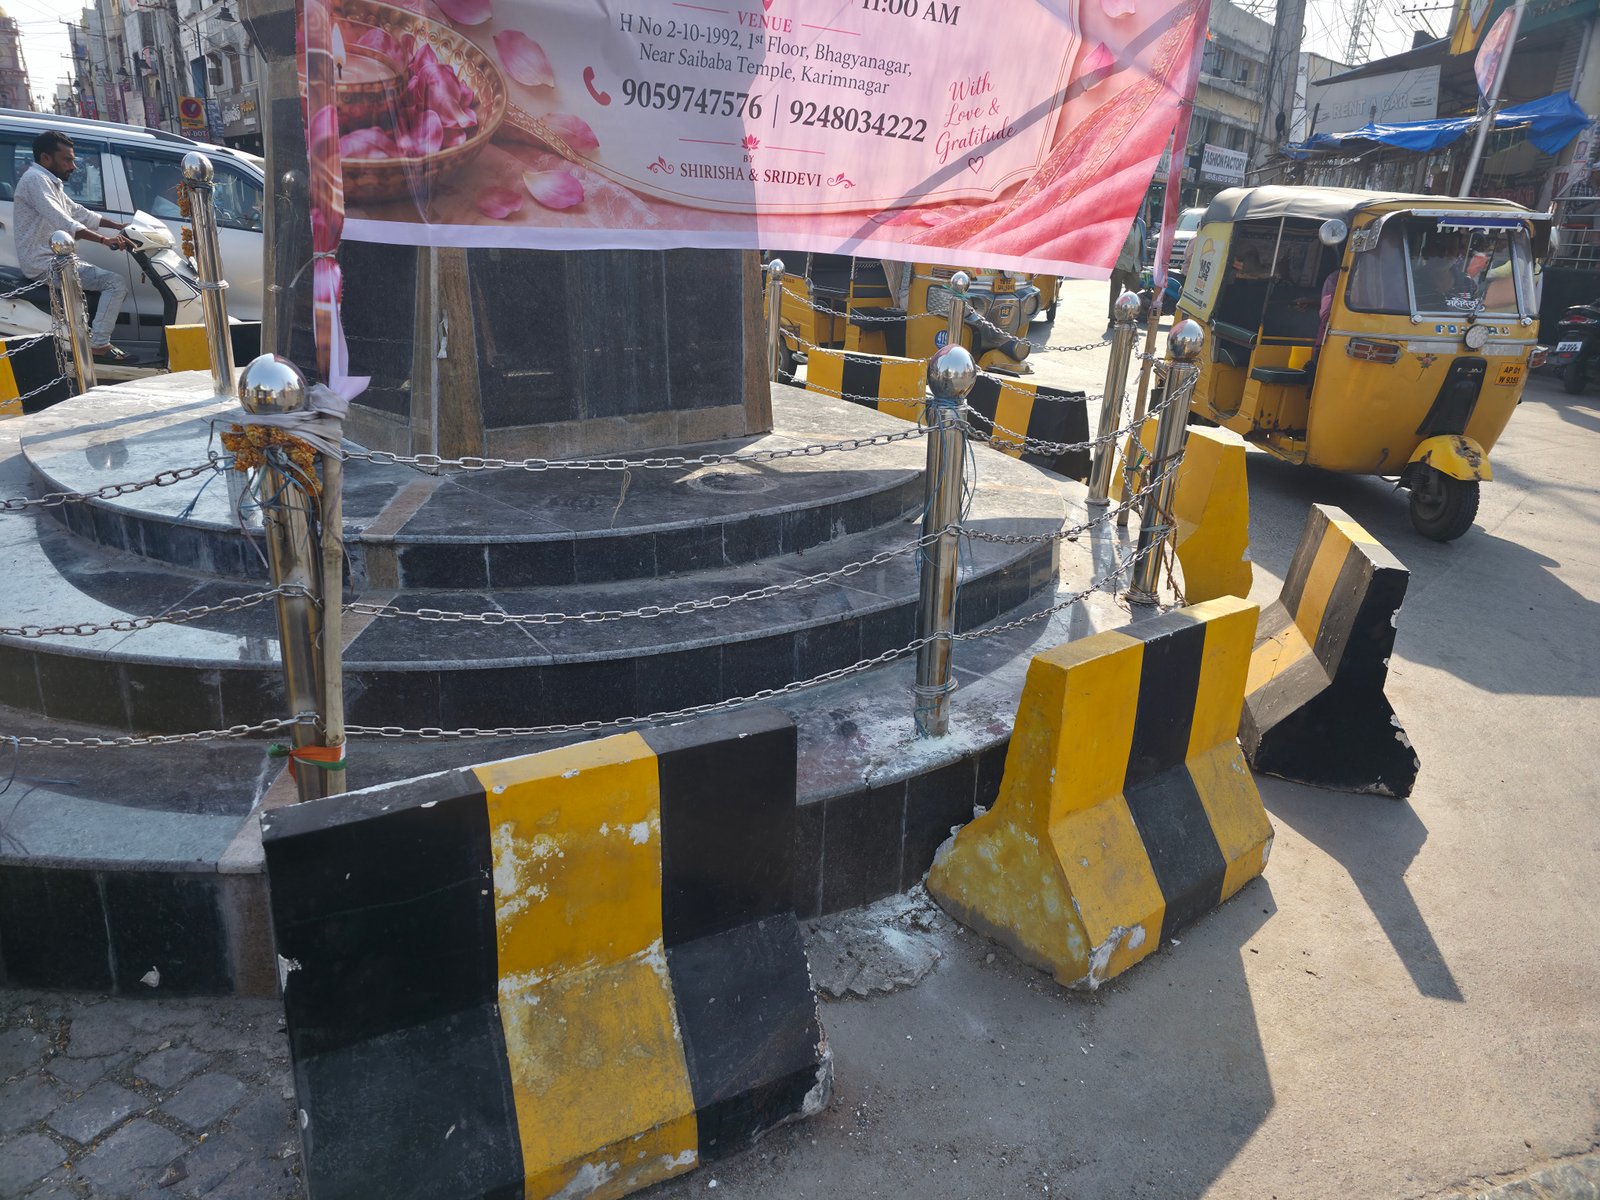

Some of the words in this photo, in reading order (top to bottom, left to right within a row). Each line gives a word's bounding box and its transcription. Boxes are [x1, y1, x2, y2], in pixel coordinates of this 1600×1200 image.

[737, 11, 793, 33] VENUE
[922, 1, 961, 26] AM
[620, 13, 633, 32] H
[638, 16, 662, 37] No
[667, 20, 742, 50] 2-10-1992,
[747, 33, 763, 50] 1st
[767, 35, 810, 60] Floor,
[815, 43, 913, 77] Bhagyanagar,
[639, 42, 675, 64] Near
[678, 48, 732, 72] Saibaba
[737, 55, 796, 82] Temple,
[801, 65, 890, 97] Karimnagar
[948, 71, 995, 101] With
[622, 78, 763, 120] 9059747576
[789, 100, 928, 142] 9248034222
[944, 103, 984, 128] Love
[988, 97, 1000, 116] &
[1332, 100, 1366, 119] RENT
[1382, 93, 1409, 111] CAR
[935, 116, 1017, 164] Gratitude
[743, 154, 755, 163] BY
[680, 162, 745, 181] SHIRISHA
[748, 168, 759, 182] &
[763, 169, 822, 187] SRIDEVI
[1503, 366, 1514, 374] AP
